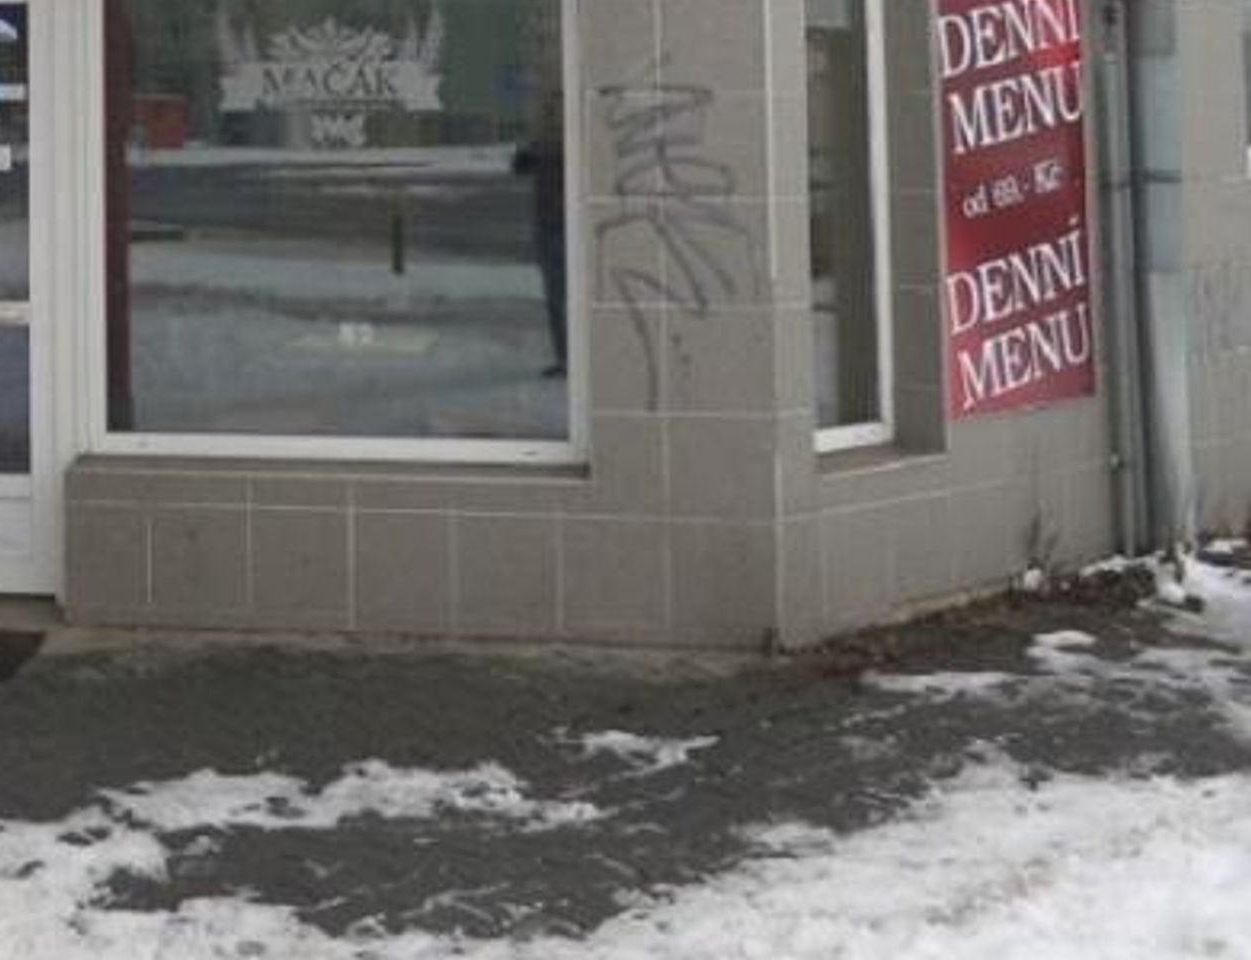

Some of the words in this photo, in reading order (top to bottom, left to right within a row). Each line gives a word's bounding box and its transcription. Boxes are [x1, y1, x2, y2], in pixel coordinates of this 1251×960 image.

[948, 61, 1084, 155] MENU
[947, 218, 1086, 335] DENNÍ
[957, 304, 1090, 411] MENU
